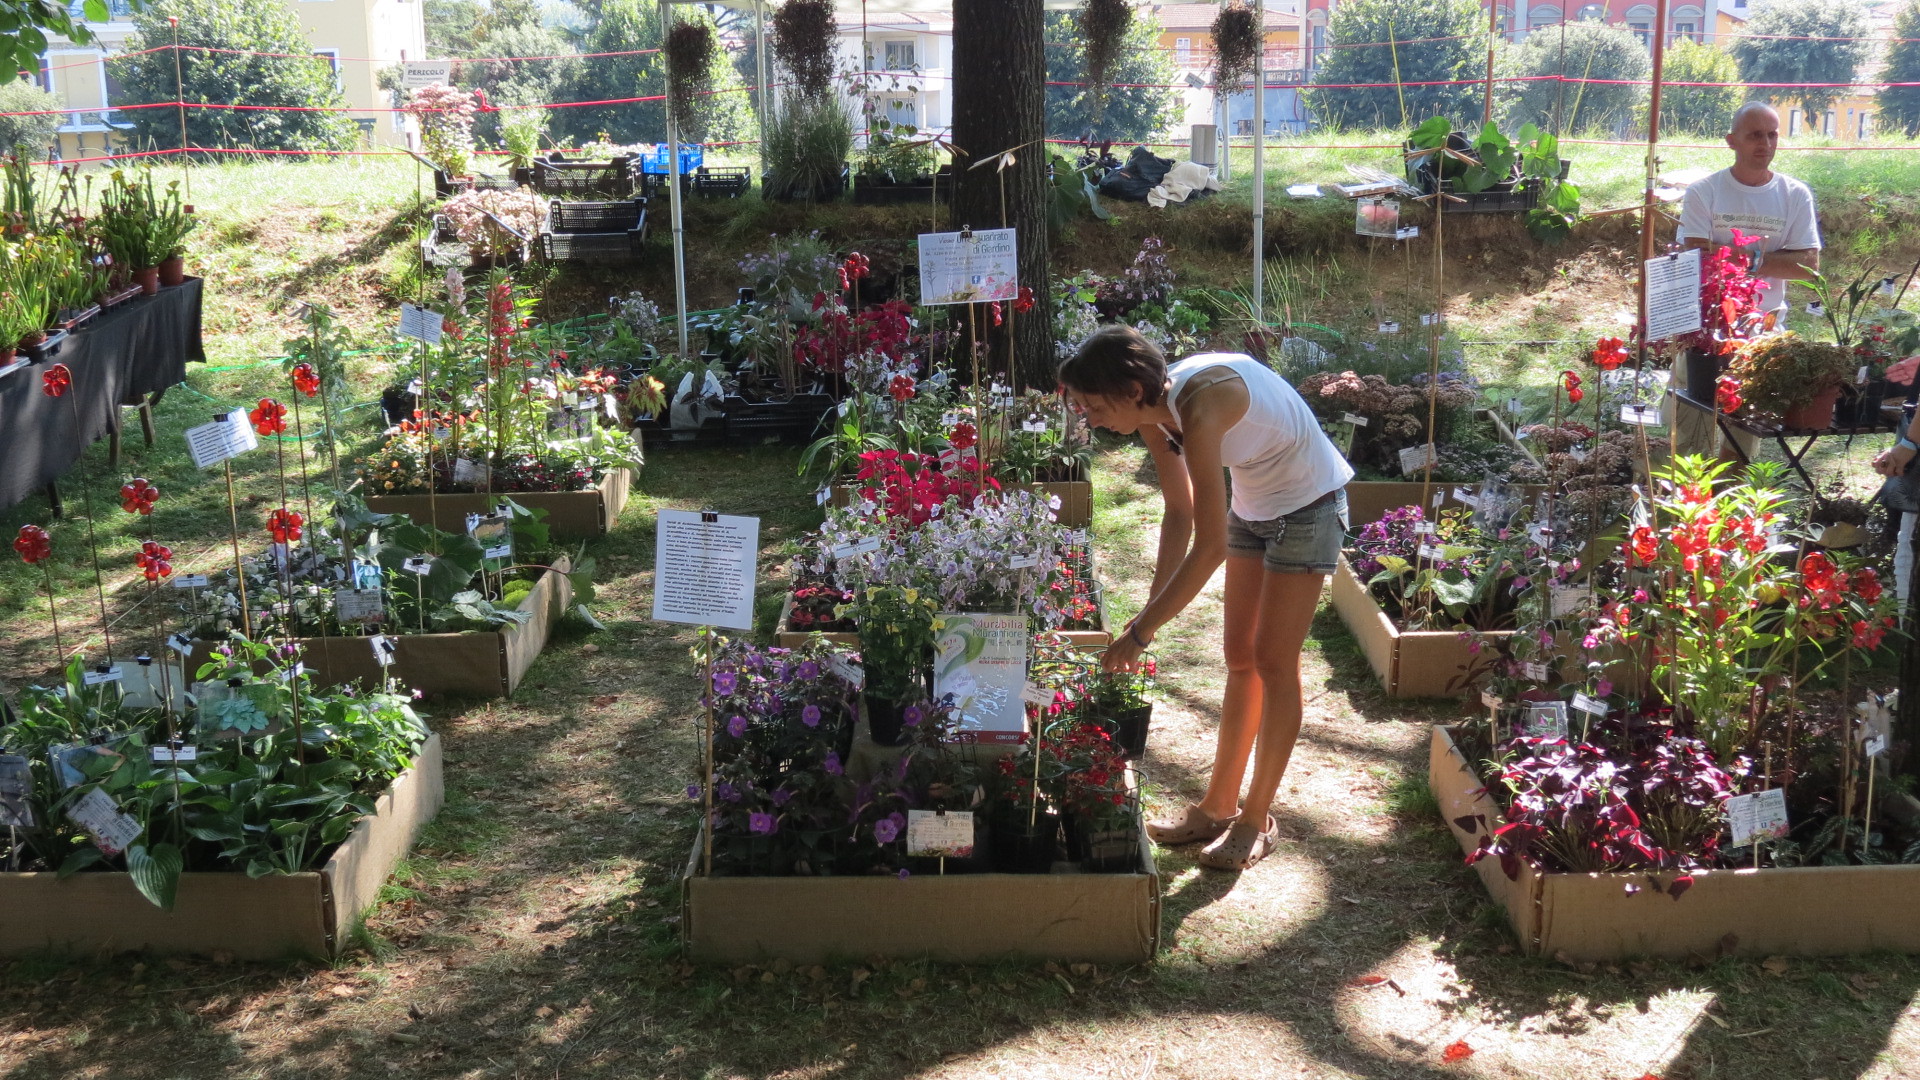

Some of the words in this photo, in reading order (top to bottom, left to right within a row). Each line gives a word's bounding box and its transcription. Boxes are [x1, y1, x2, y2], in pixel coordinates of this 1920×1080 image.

[972, 245, 980, 254] di
[982, 243, 1010, 254] Giardino
[972, 620, 1022, 629] Murabilia
